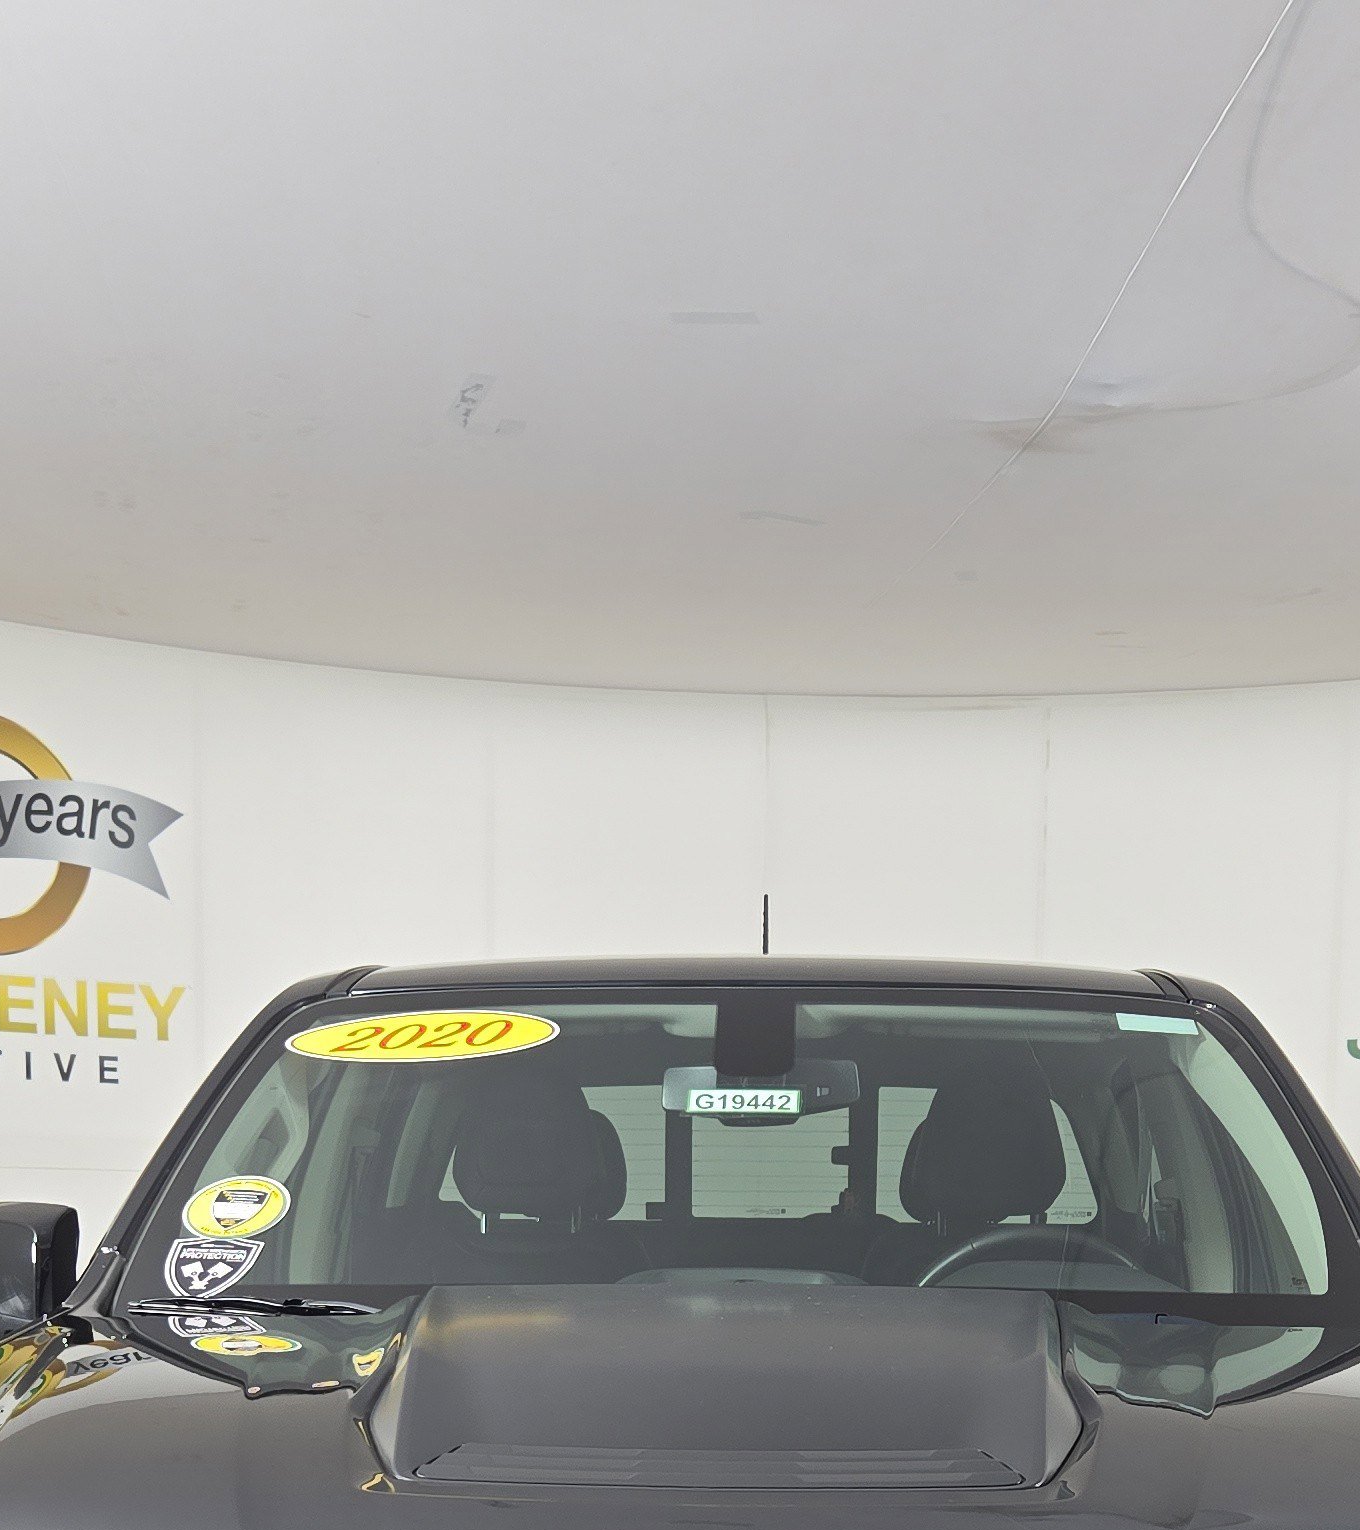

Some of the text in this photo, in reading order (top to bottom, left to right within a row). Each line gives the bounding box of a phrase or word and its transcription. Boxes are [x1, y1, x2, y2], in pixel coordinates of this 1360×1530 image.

[328, 1019, 514, 1052] 2020
[695, 1093, 792, 1111] G19442
[180, 1251, 247, 1261] PROTECTION
